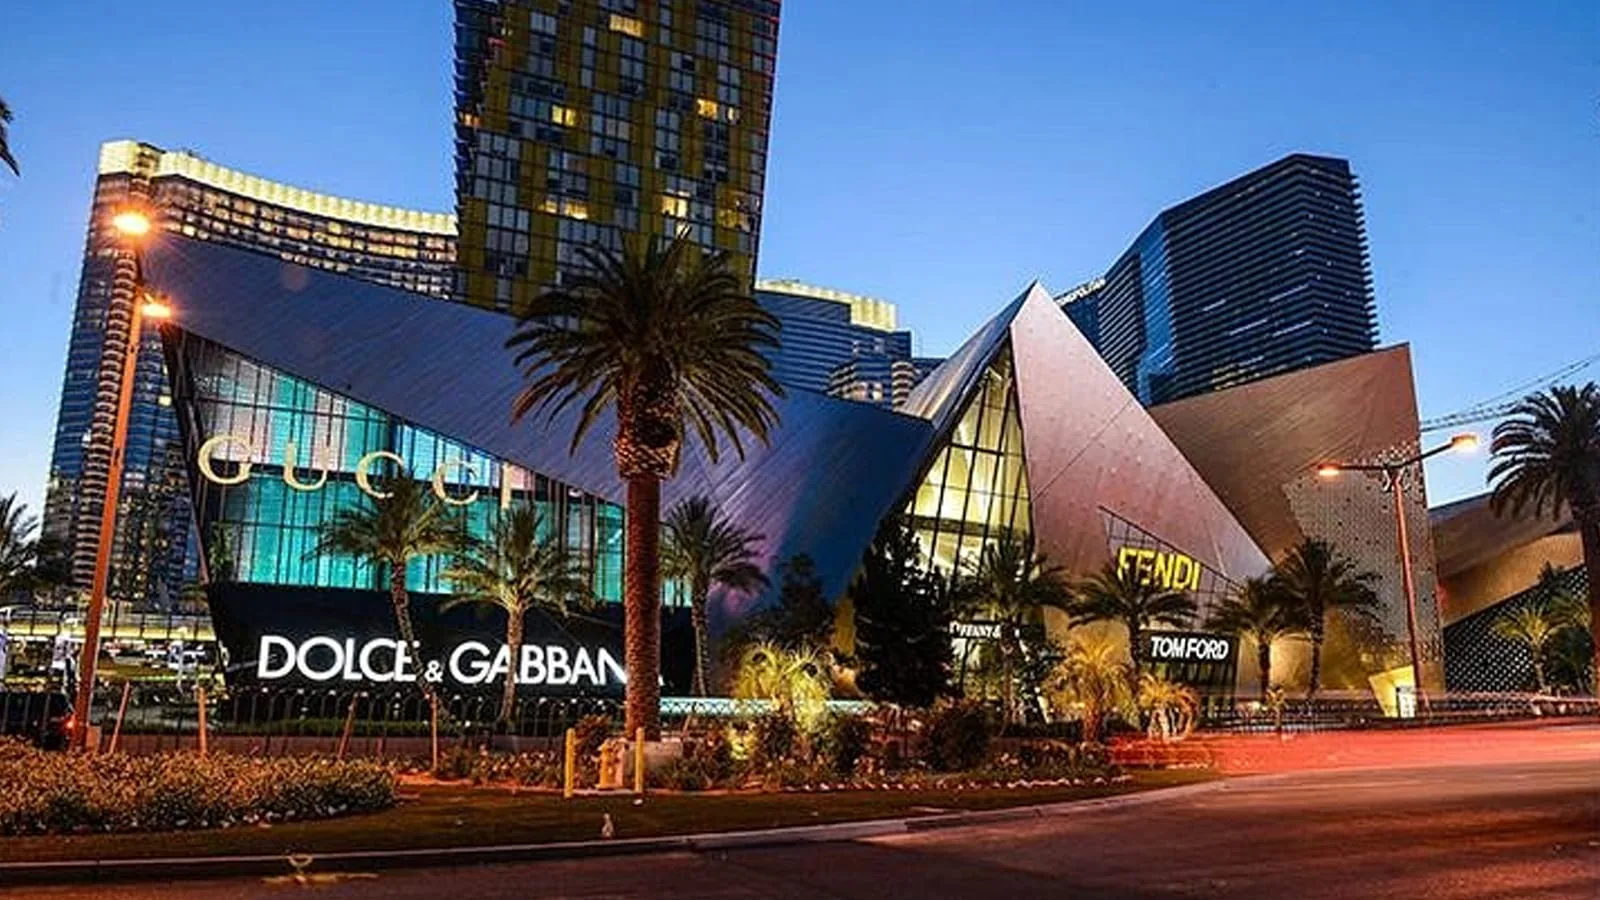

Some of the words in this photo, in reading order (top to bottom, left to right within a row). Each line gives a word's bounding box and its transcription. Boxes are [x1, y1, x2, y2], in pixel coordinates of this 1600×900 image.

[199, 434, 512, 508] GUCCI
[1117, 547, 1200, 591] FENDI
[257, 635, 421, 682] DOLCE
[424, 660, 443, 682] &
[449, 641, 665, 686] GABBAN
[1151, 636, 1185, 658] TOM
[1185, 638, 1229, 660] FORD
